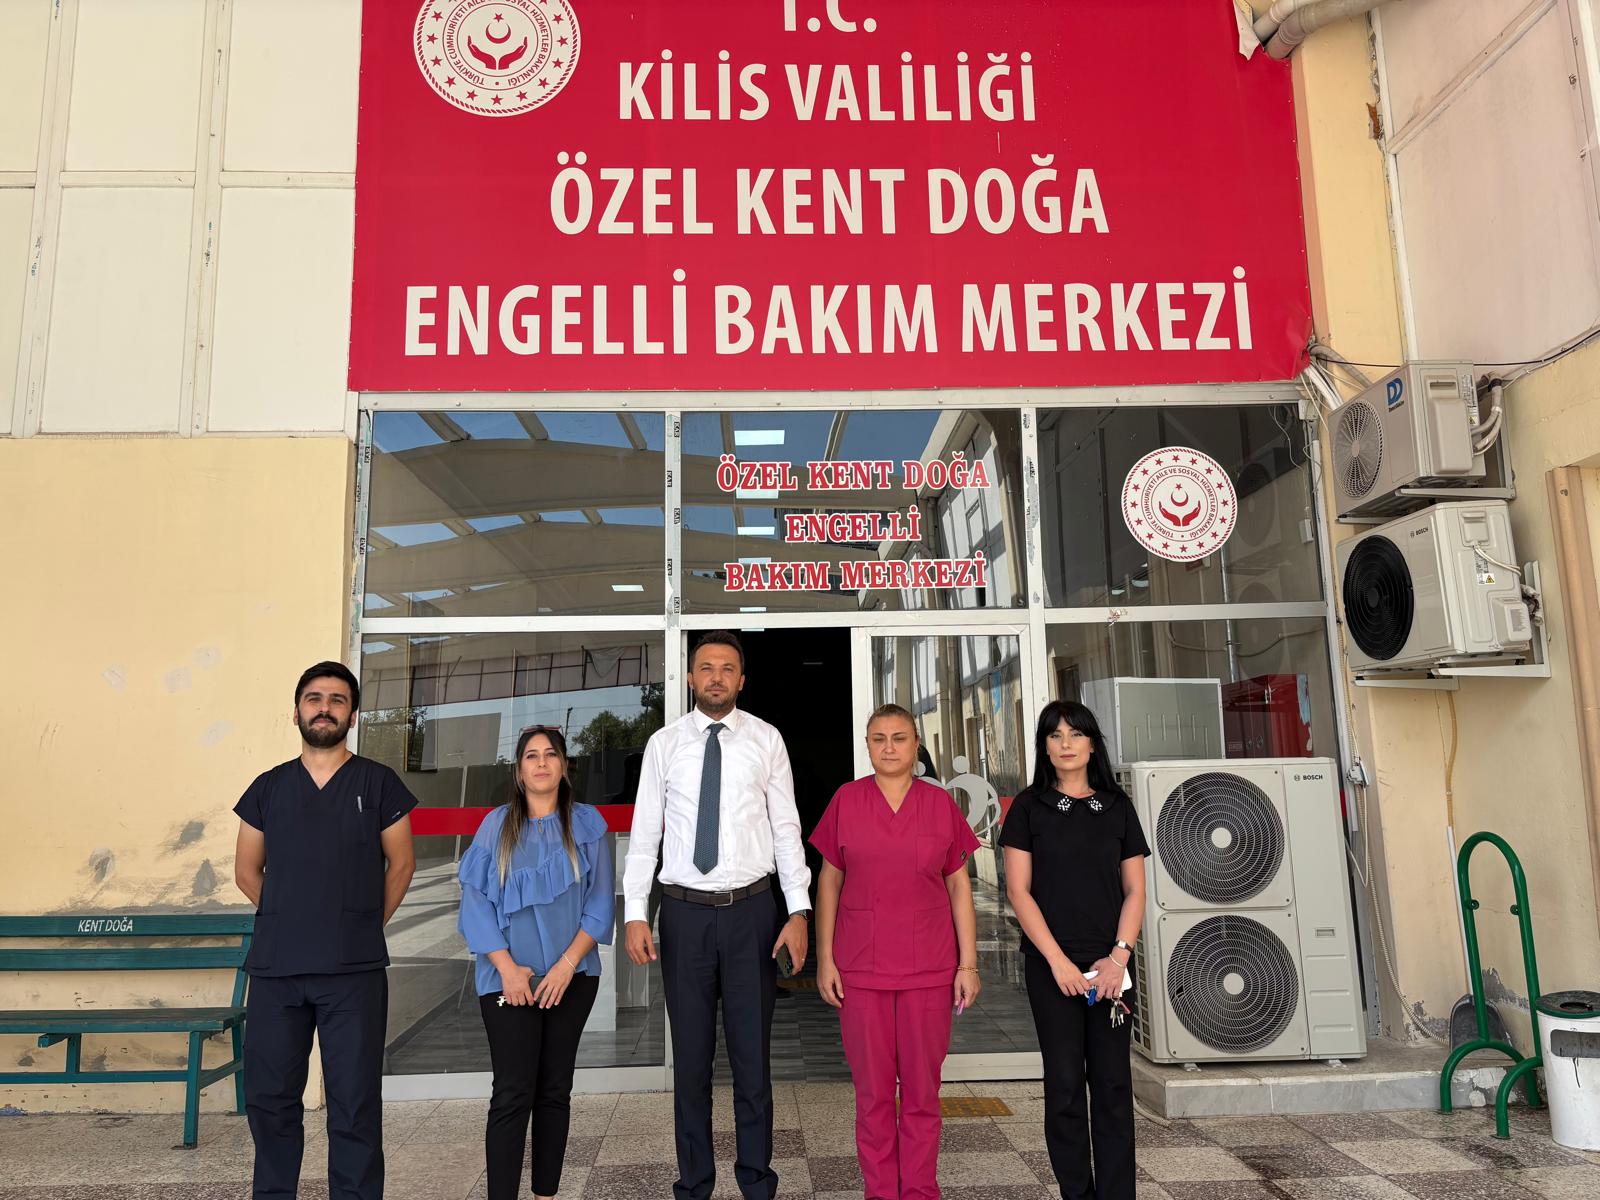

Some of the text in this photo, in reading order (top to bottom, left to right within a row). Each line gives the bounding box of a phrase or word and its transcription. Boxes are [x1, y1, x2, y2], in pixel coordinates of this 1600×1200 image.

[446, 4, 467, 59] CUMHURİYETİ
[530, 9, 550, 53] HİZMETLER
[453, 59, 485, 85] TÜRKİYE
[508, 54, 546, 86] BAKANLIĞI
[620, 48, 1036, 122] KİLİS VALİLİĞİ
[550, 151, 1110, 235] ÖZEL KENT DOĞA
[404, 265, 1253, 356] ENGELLİ BAKIM MERKEZİ
[717, 454, 798, 492] ÖZEL
[807, 460, 894, 490] KENT
[903, 451, 991, 490] DOĞA
[1178, 468, 1200, 481] SOSYAL
[785, 505, 922, 543] ENGELLİ
[724, 550, 987, 592] BAKIM MERKEZİ
[78, 916, 133, 932] KENT DOĞA
